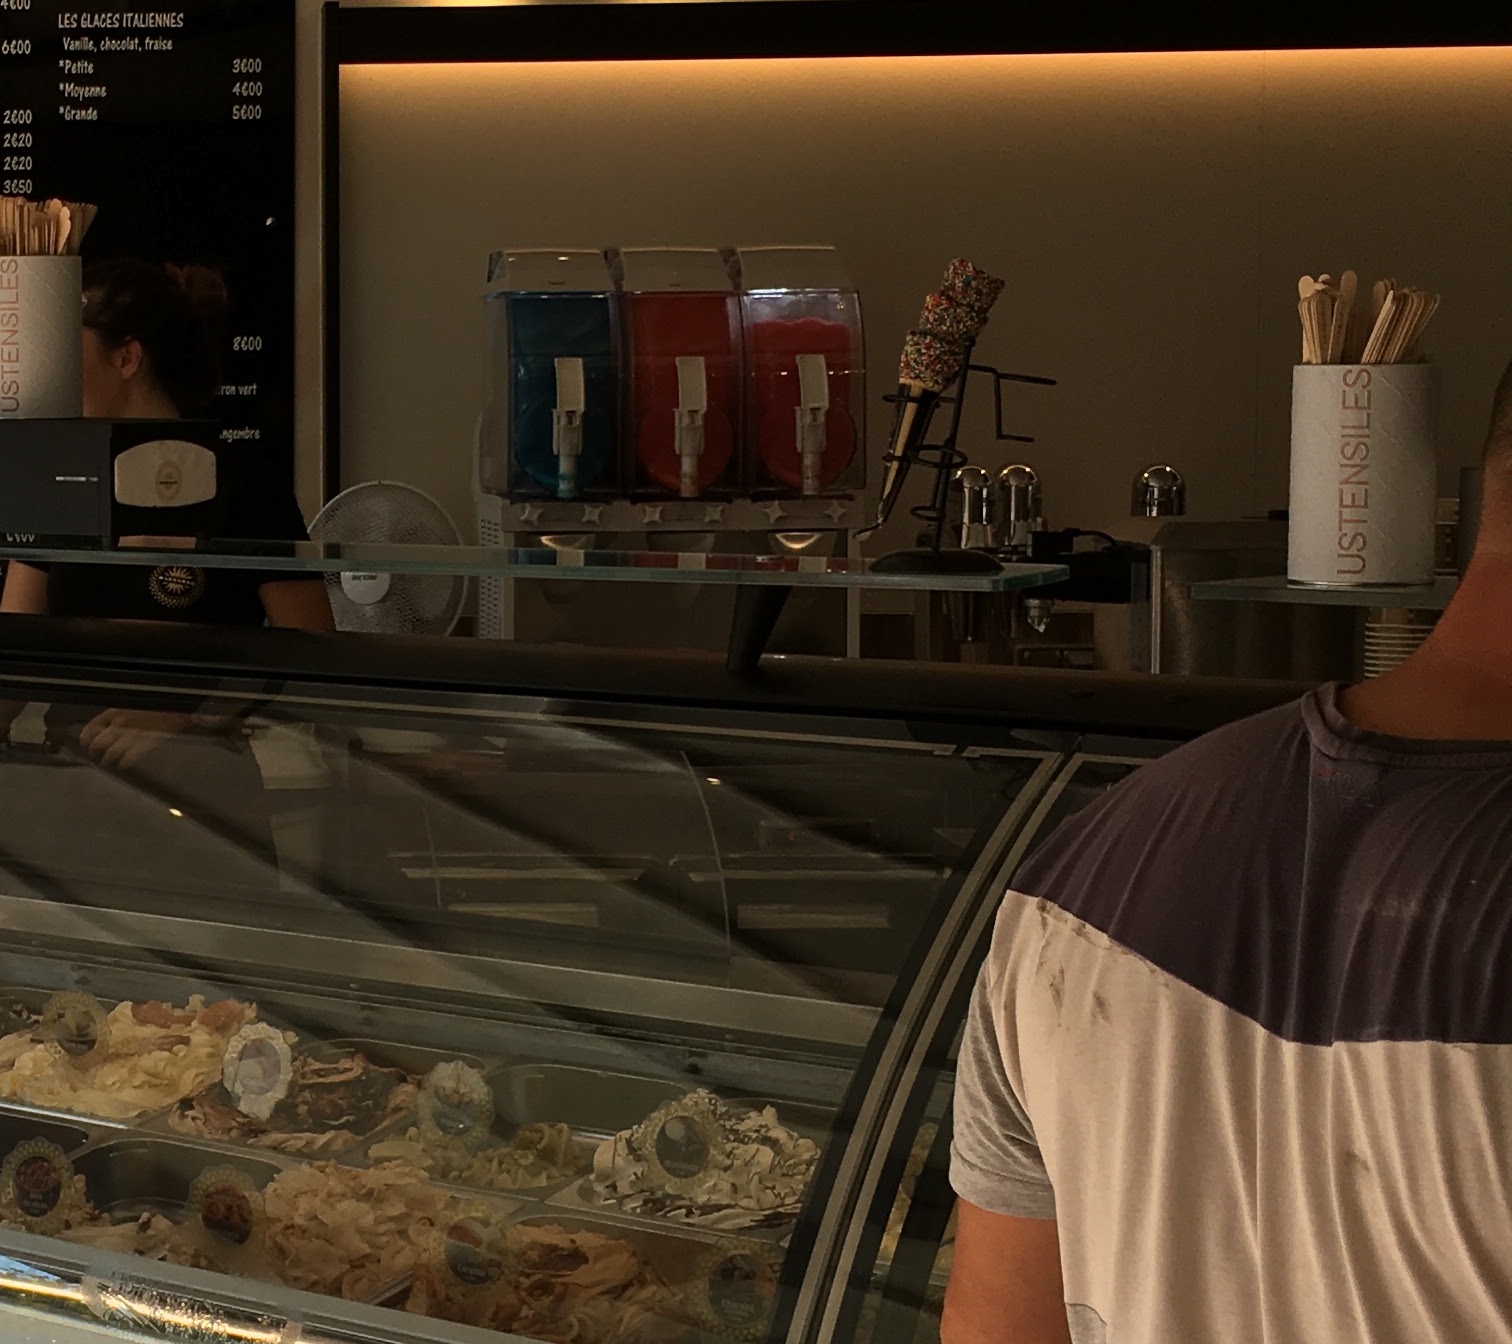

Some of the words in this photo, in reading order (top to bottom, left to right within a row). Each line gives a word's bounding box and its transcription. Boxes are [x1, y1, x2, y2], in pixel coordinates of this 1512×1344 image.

[59, 13, 77, 28] LES
[81, 13, 119, 28] GLACES
[123, 13, 183, 27] ITALIENNES
[2, 40, 31, 55] 6€00
[145, 37, 172, 50] fraise
[233, 59, 261, 73] 3€00
[233, 82, 262, 96] 4€00
[4, 110, 32, 124] 2€00
[233, 105, 261, 119] 5€00
[4, 133, 32, 147] 2€20
[4, 156, 32, 170] 2€20
[3, 179, 33, 194] 3€50
[0, 258, 19, 413] USTENSILES
[233, 336, 262, 350] 8€00
[1336, 367, 1372, 575] USTENSILES
